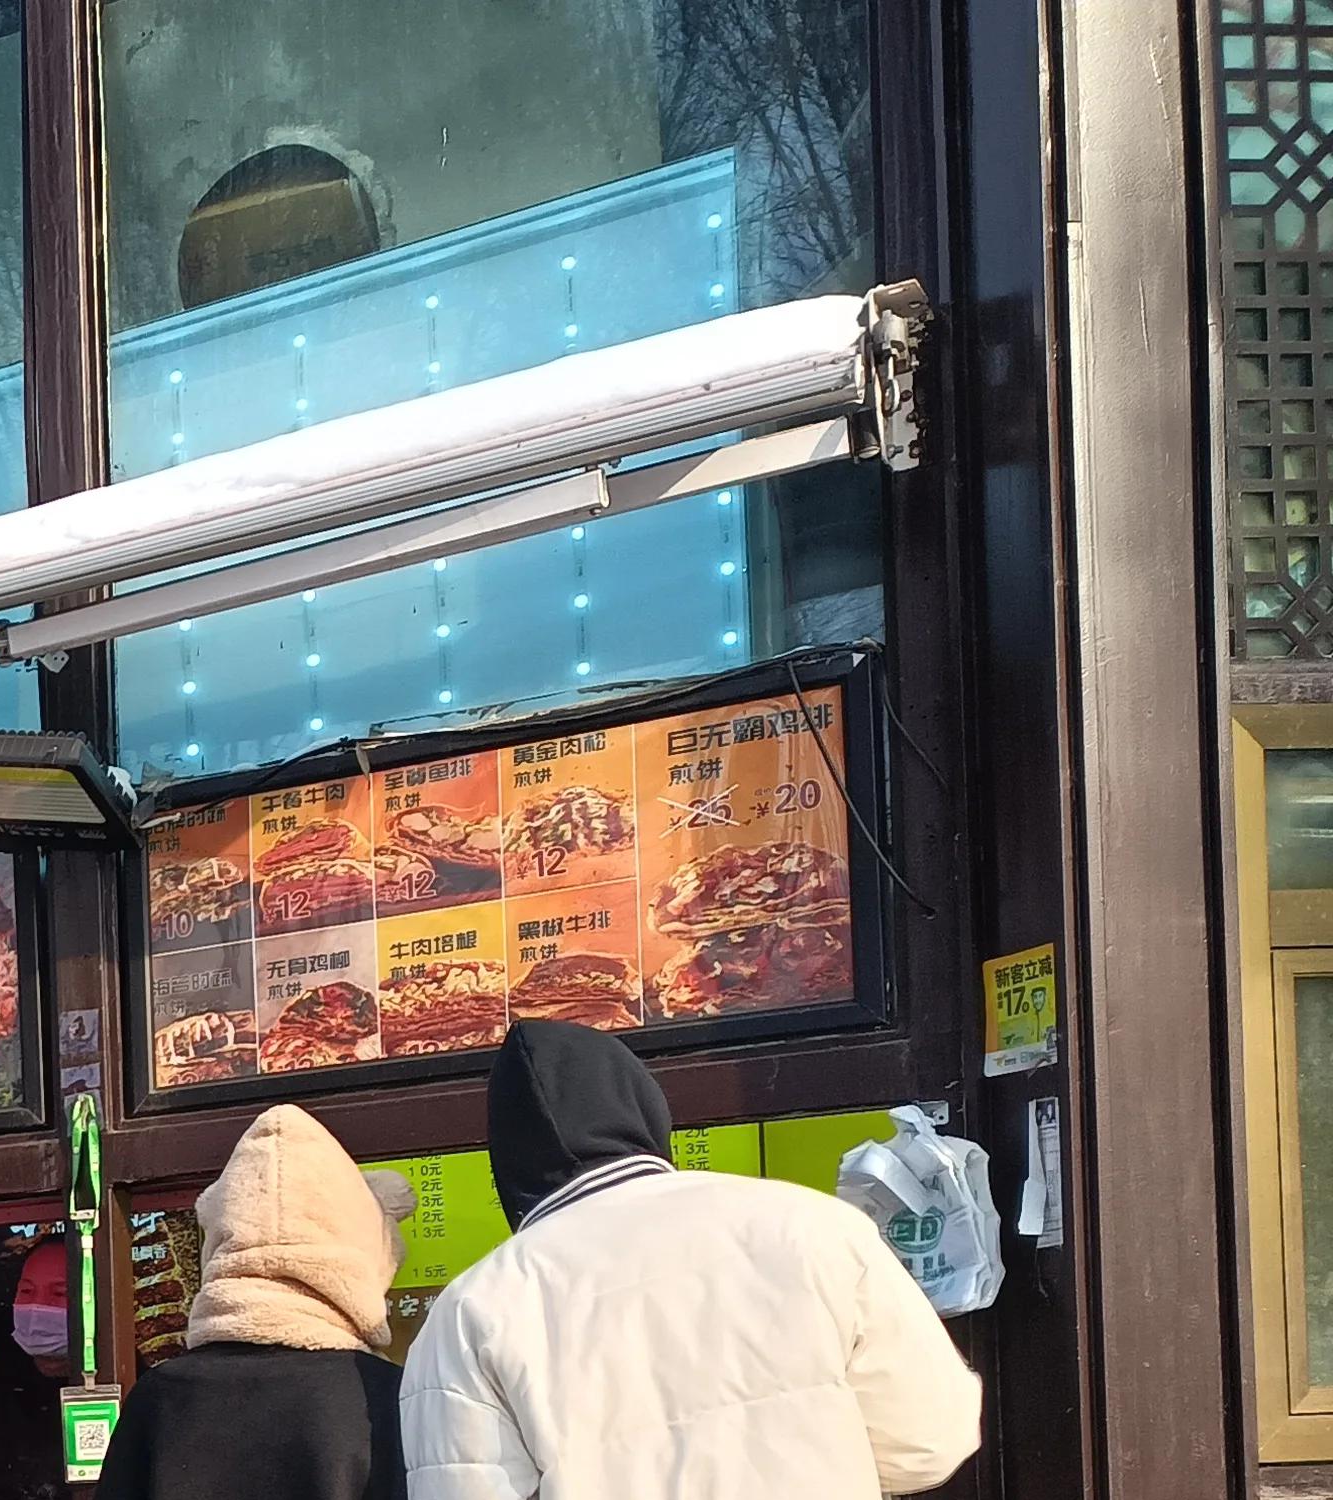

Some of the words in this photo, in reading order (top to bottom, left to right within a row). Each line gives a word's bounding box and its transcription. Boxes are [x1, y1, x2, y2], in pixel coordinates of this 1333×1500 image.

[668, 704, 833, 757] 巨无霸鸡排
[513, 732, 607, 767] 黄金肉松
[384, 758, 473, 791] 至尊鱼排
[513, 767, 553, 788] 煎饼
[668, 757, 724, 787] 煎饼
[261, 784, 346, 812] 午餐牛肉
[385, 792, 422, 812] 煎饼
[262, 815, 297, 835] 煎饼
[518, 910, 612, 941] 黑椒牛排
[389, 930, 478, 960] 牛肉培根
[519, 943, 558, 964] 煎饼
[266, 950, 351, 981] 无骨鸡柳
[389, 962, 427, 981] 煎饼
[994, 954, 1053, 990] 新客立减
[267, 981, 303, 1001] 煎饼
